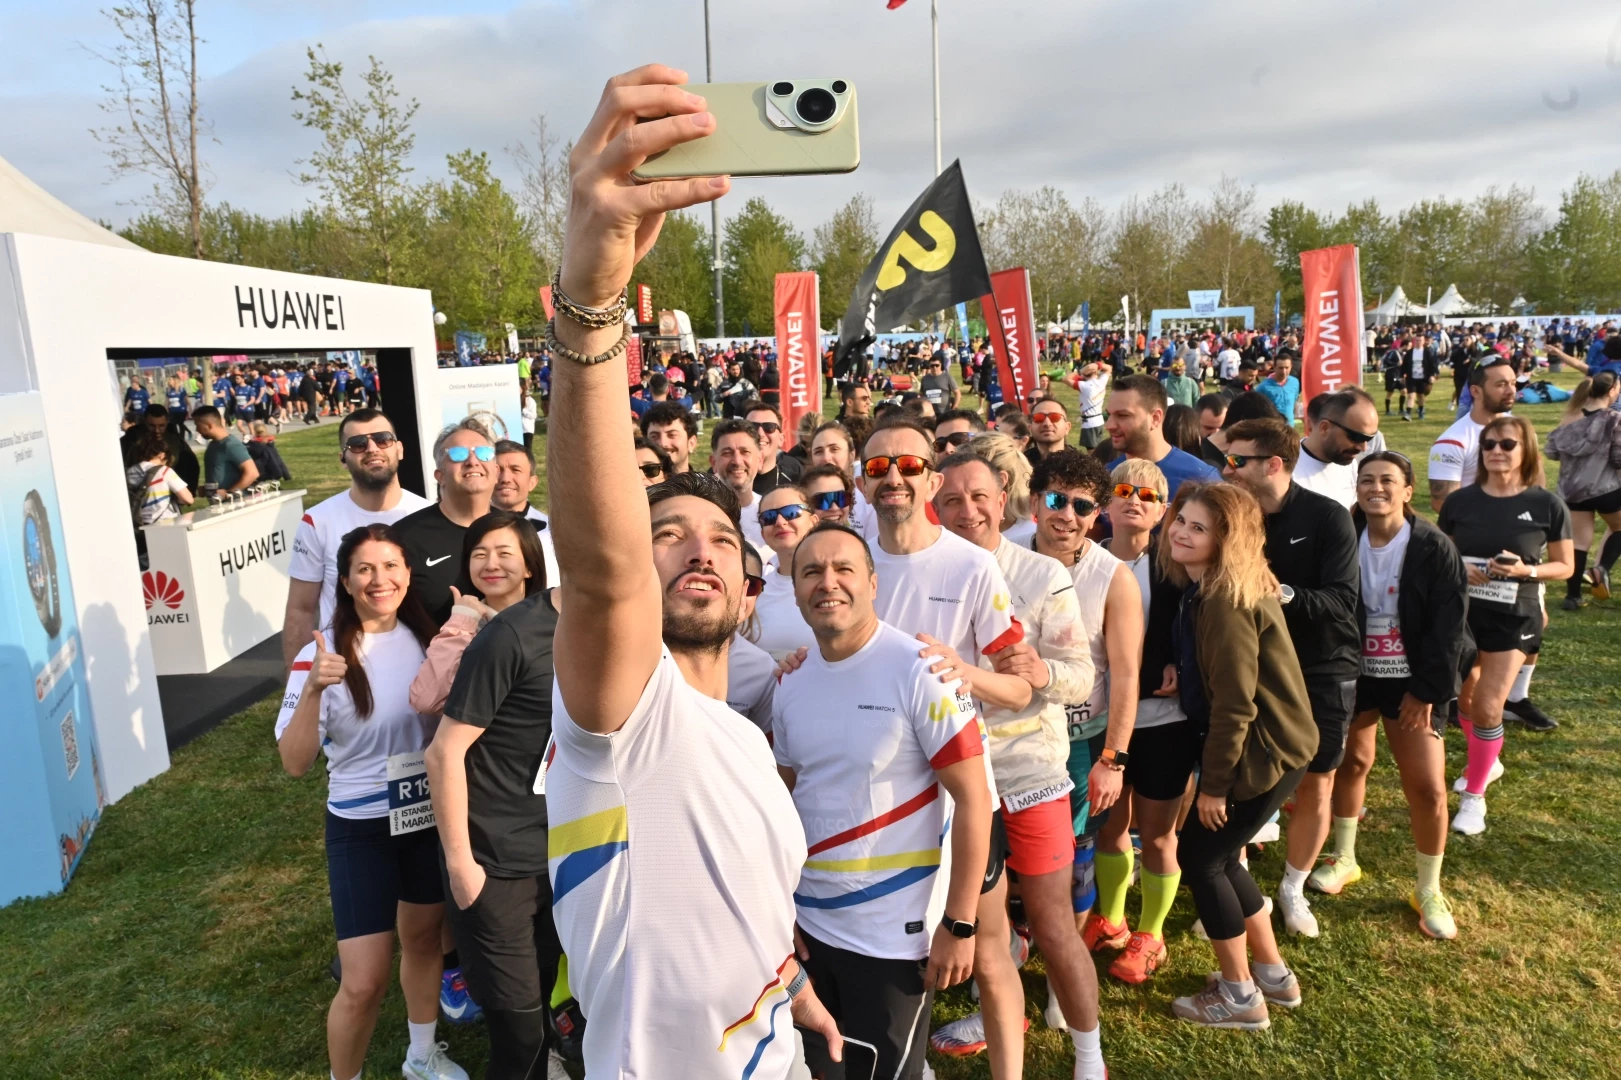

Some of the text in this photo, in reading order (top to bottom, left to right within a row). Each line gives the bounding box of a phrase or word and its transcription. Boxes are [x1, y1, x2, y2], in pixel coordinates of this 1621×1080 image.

[235, 285, 345, 330] HUAWEI
[219, 529, 287, 577] HUAWEI
[1366, 637, 1404, 653] D 36
[1367, 666, 1410, 675] MARATHO
[398, 781, 412, 800] R
[1017, 782, 1067, 809] MARATHON
[401, 813, 436, 830] MARAT
